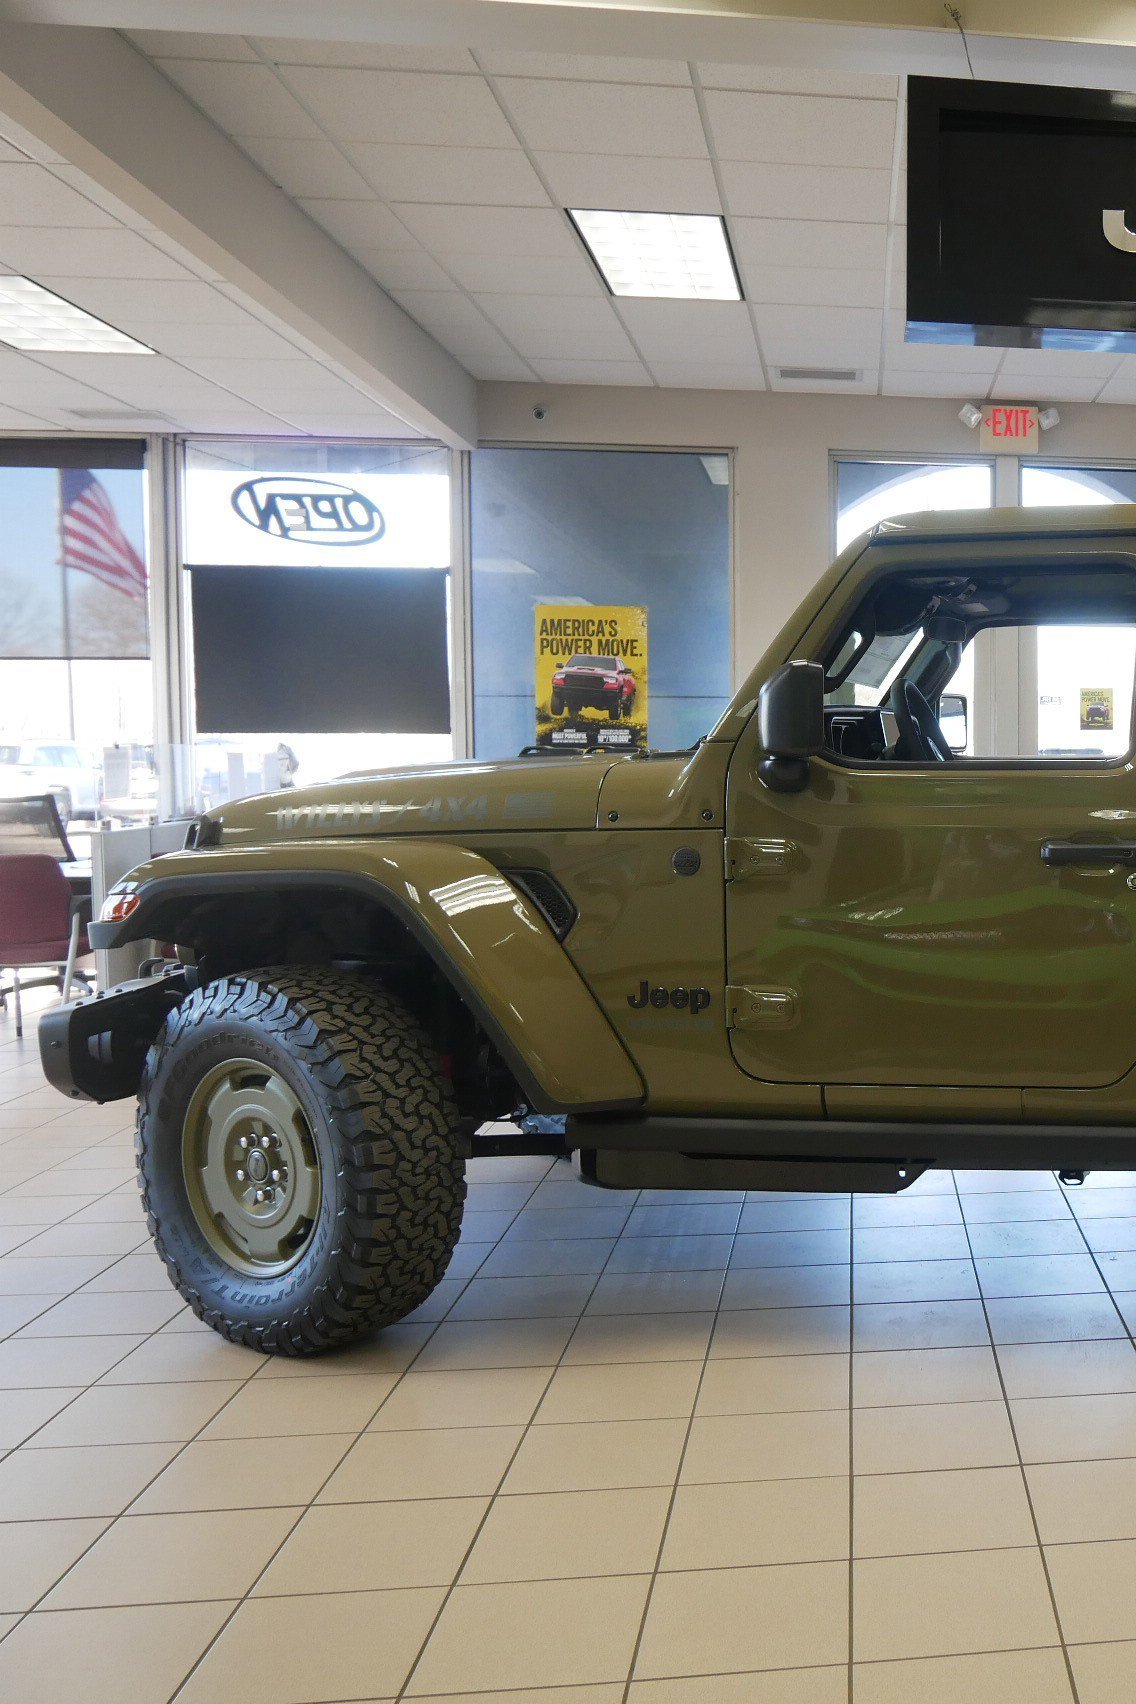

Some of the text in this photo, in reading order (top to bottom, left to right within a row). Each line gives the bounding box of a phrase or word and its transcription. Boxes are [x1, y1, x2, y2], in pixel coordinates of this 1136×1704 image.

[992, 408, 1030, 437] EXIT
[540, 618, 618, 637] AMERICA'S
[540, 638, 643, 657] POWER MOVE.
[276, 800, 388, 830] WILLYS
[626, 980, 710, 1014] Jeep
